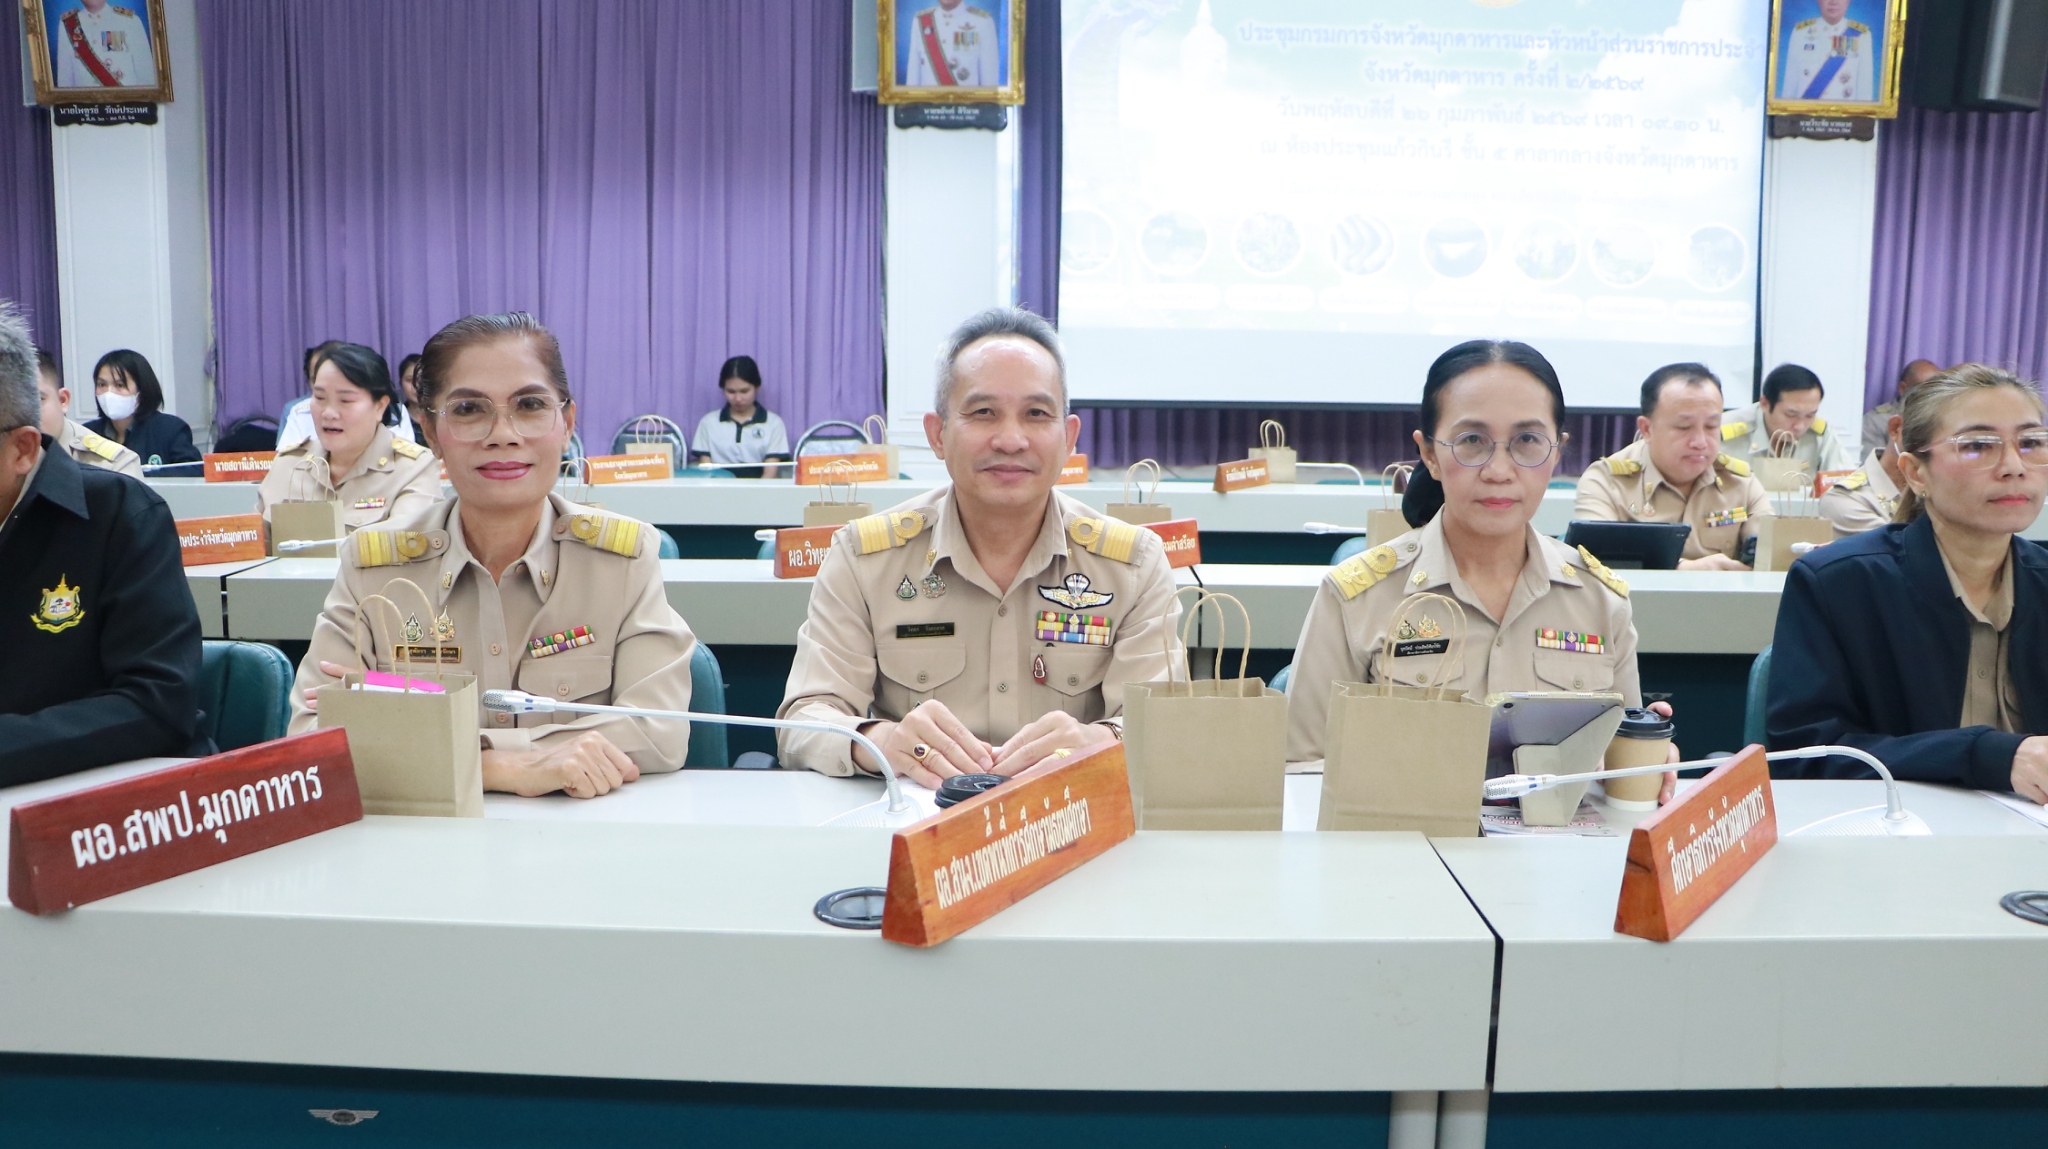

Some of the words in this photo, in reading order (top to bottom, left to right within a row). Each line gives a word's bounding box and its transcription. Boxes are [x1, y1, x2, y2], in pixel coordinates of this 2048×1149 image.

[1364, 60, 1505, 92] จังหวัดมุกดาหาร
[1513, 59, 1560, 89] ครั้งที่
[1436, 100, 1526, 129] กุมภาพันธ์
[1594, 111, 1634, 128] เวลา
[1460, 132, 1486, 160] ชั้น
[70, 765, 323, 868] ผอ.สพป.มุกดาหาร
[1667, 784, 1767, 895] ศึกษาธิการจังหวัดมุกดาหาร
